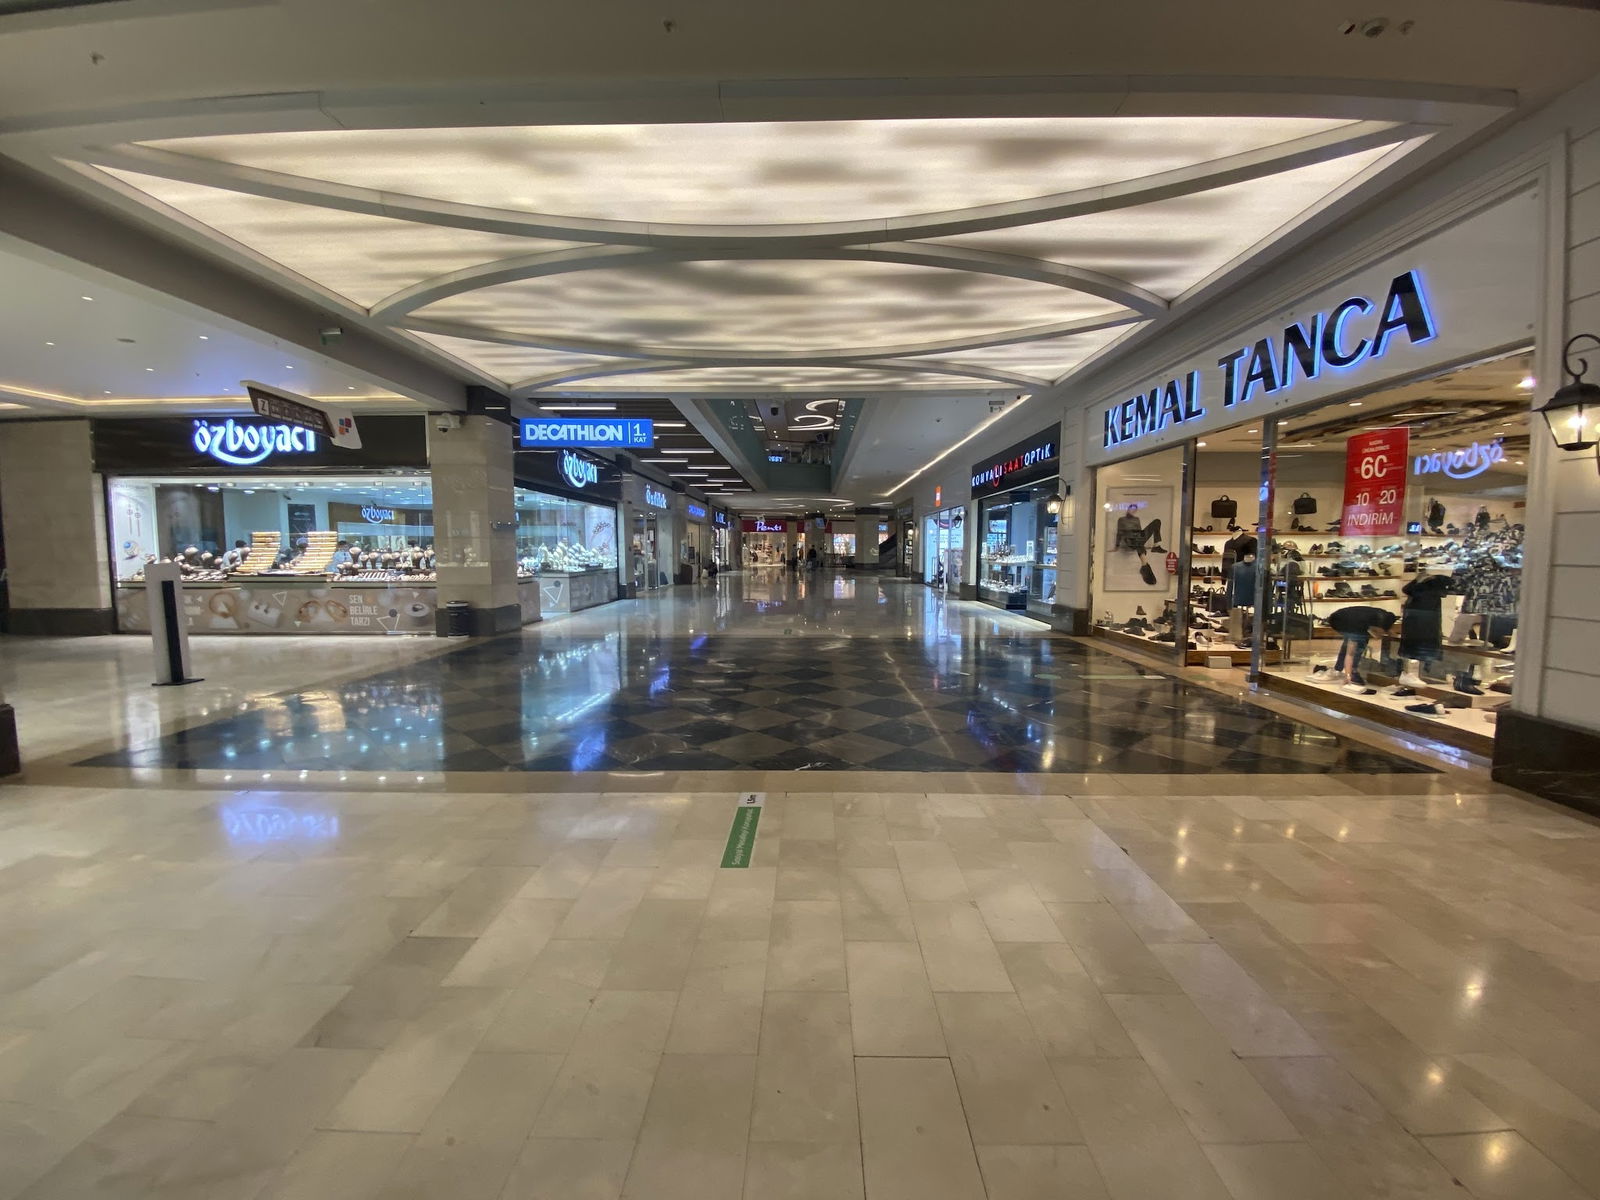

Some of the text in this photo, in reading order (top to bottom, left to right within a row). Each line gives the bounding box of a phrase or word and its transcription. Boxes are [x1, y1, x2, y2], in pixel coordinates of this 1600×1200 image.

[1102, 268, 1437, 448] KEMAL TANCA
[525, 424, 623, 441] DECATHLON
[633, 423, 646, 437] 1.
[1355, 489, 1397, 507] 10 20
[349, 595, 363, 604] SEN
